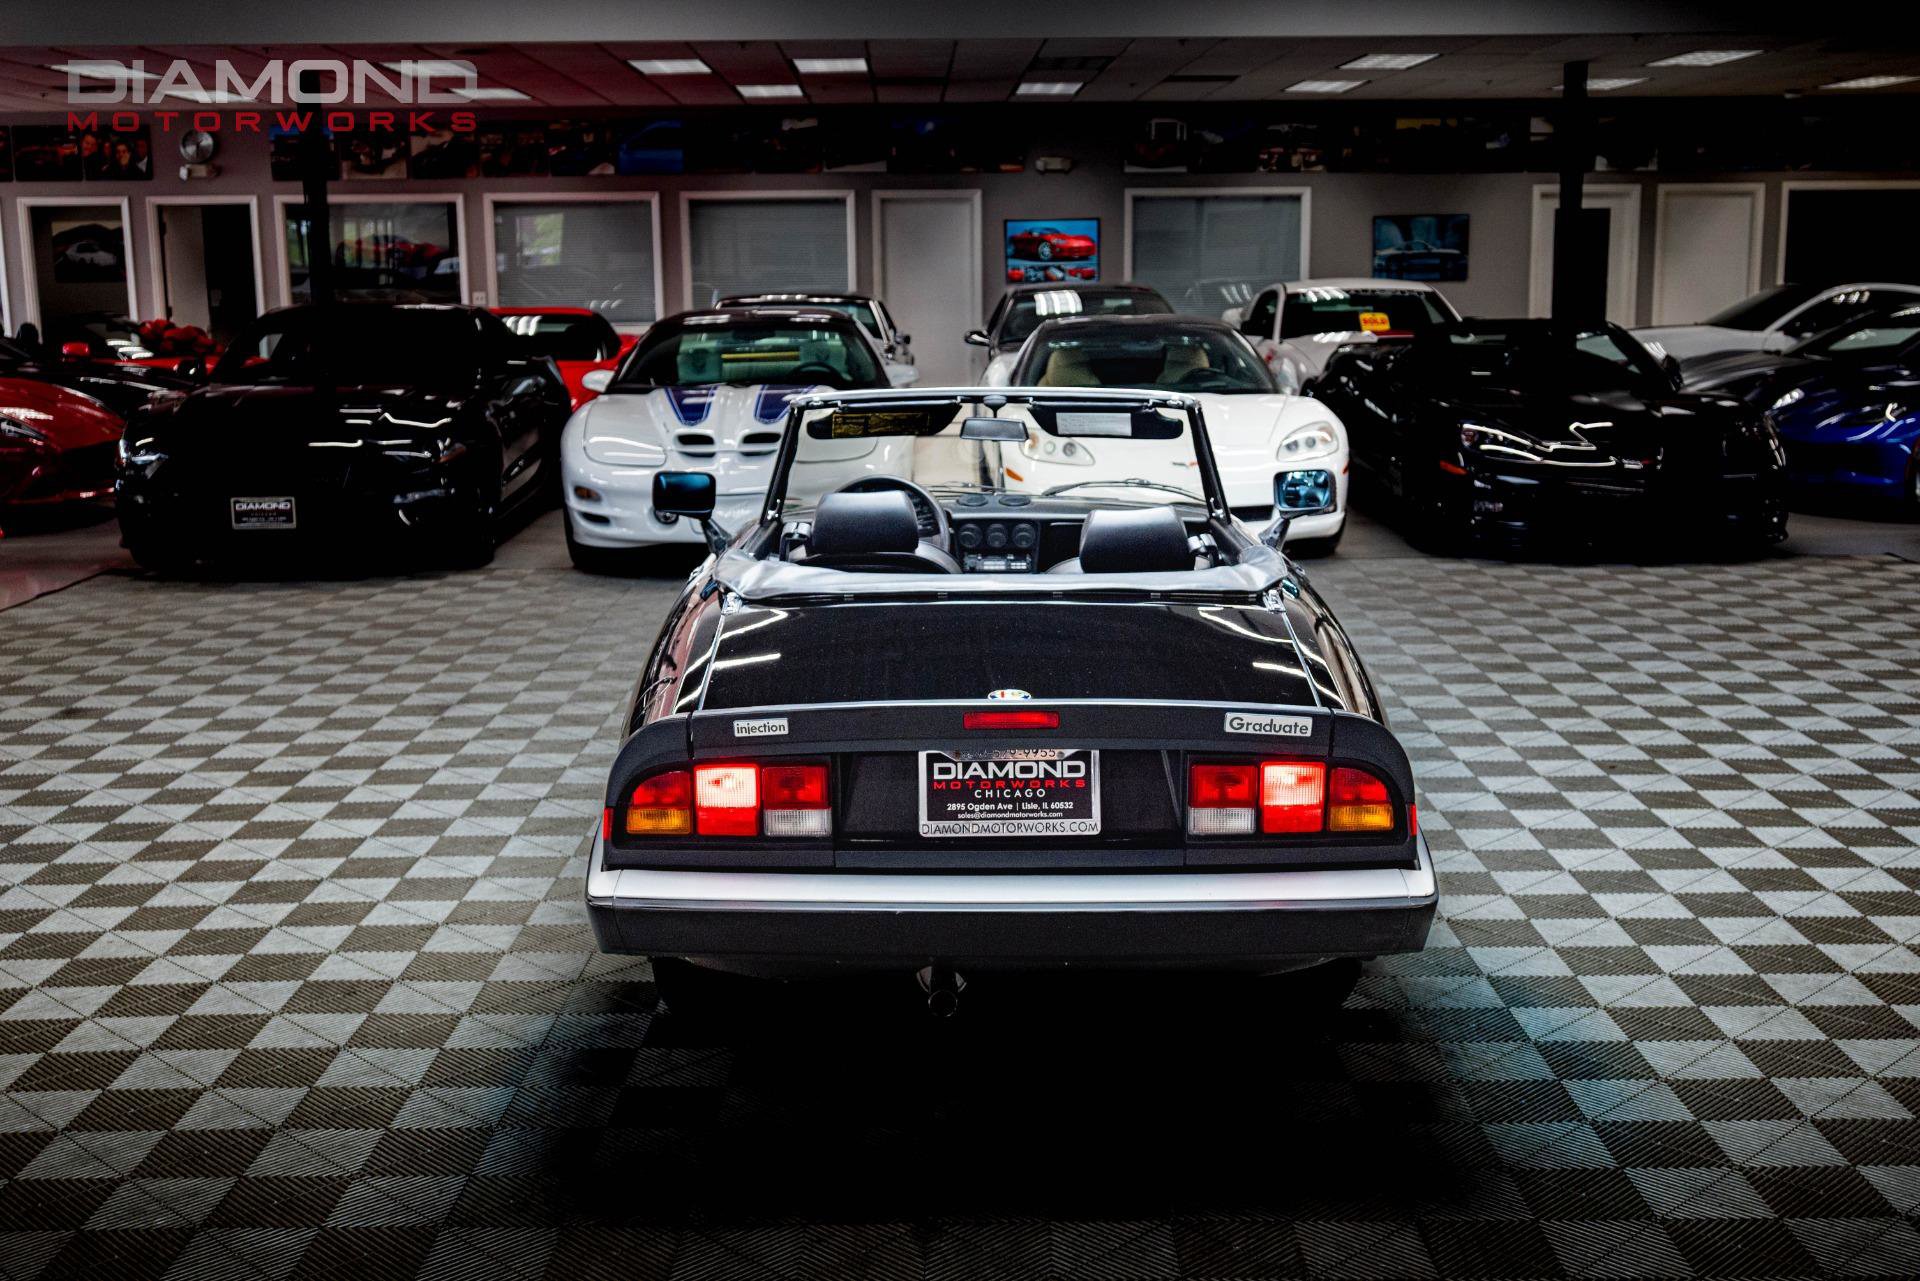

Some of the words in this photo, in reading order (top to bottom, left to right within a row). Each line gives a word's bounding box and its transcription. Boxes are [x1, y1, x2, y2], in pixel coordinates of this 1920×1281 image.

[235, 502, 291, 511] DIAMOND
[736, 722, 786, 734] injection
[1229, 717, 1309, 735] Graduate
[933, 760, 1086, 780] DIAMOND
[933, 780, 1086, 790] MOTORWORKS
[974, 788, 1046, 798] CHICAGO
[946, 803, 966, 811] 2895
[967, 802, 995, 812] Ogden
[997, 802, 1014, 811] Ave
[1042, 801, 1049, 810] IL
[1050, 801, 1074, 810] 60532
[957, 811, 1063, 820] sales@diamondmotorworks.com
[921, 822, 1099, 836] DIAMONDMOTORWORKS.COM
